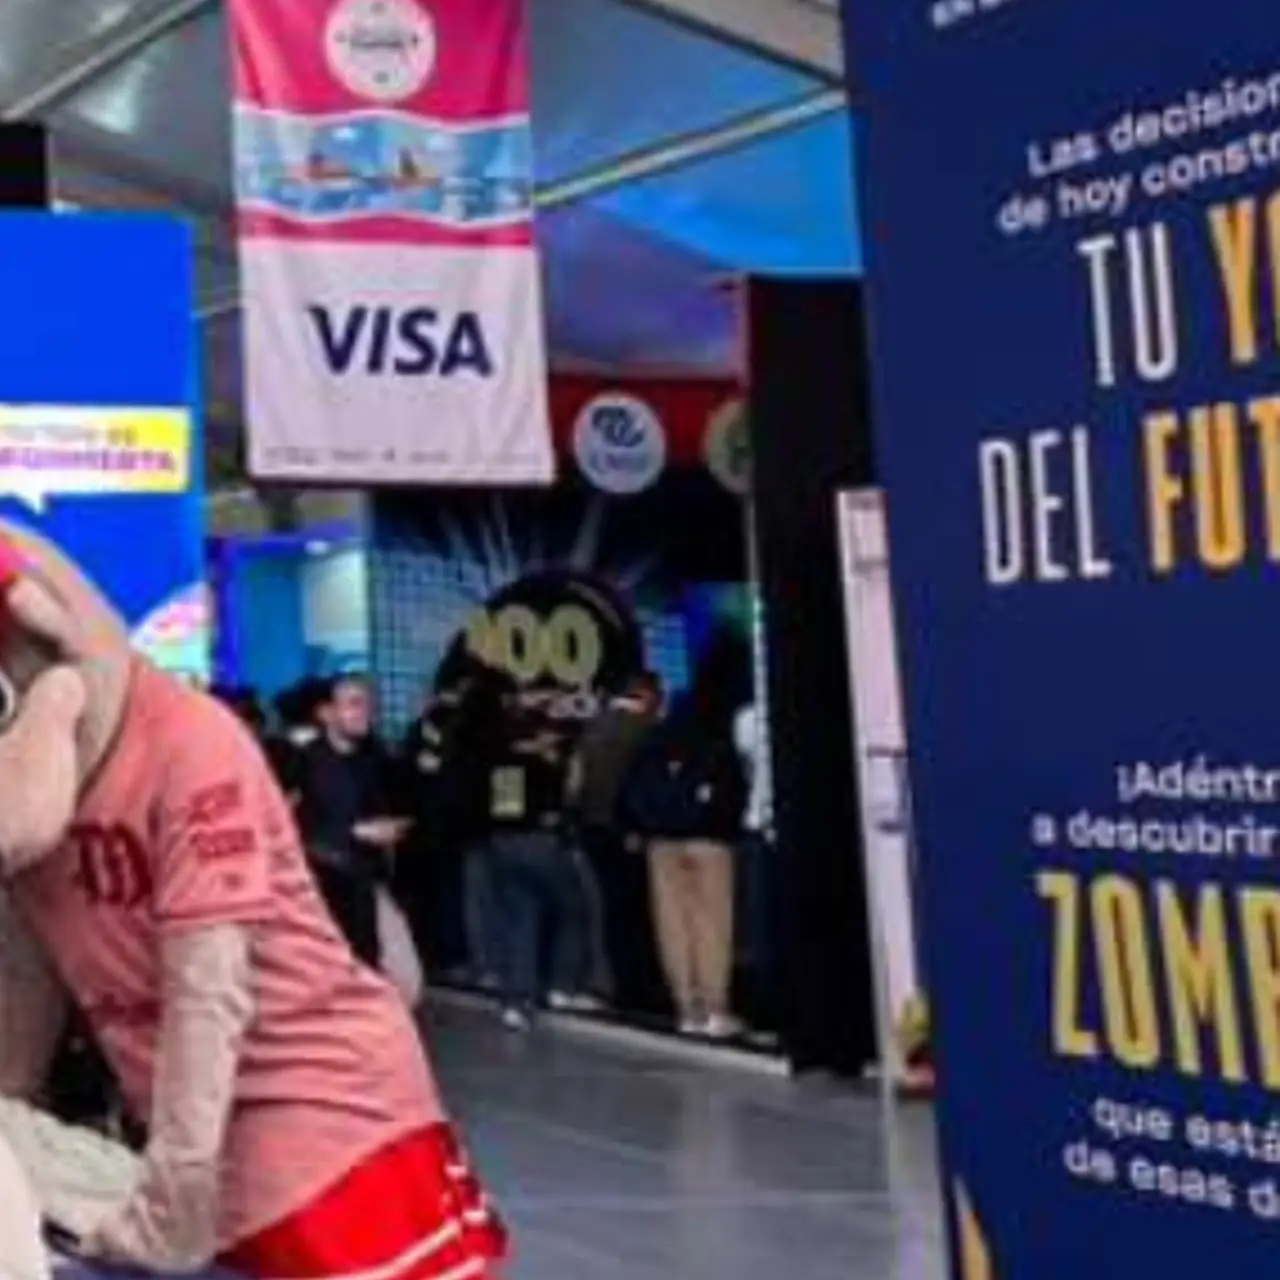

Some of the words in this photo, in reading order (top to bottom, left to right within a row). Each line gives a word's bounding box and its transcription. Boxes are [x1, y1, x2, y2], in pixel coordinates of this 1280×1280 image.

[1027, 132, 1100, 178] Las
[999, 190, 1050, 234] de
[1056, 172, 1134, 218] hoy
[1076, 220, 1178, 388] TU
[309, 305, 494, 379] VISA
[977, 424, 1113, 586] DEL
[1066, 807, 1280, 858] descubrir
[1093, 1096, 1172, 1142] que
[1062, 1137, 1117, 1183] de
[1128, 1154, 1236, 1210] esas
